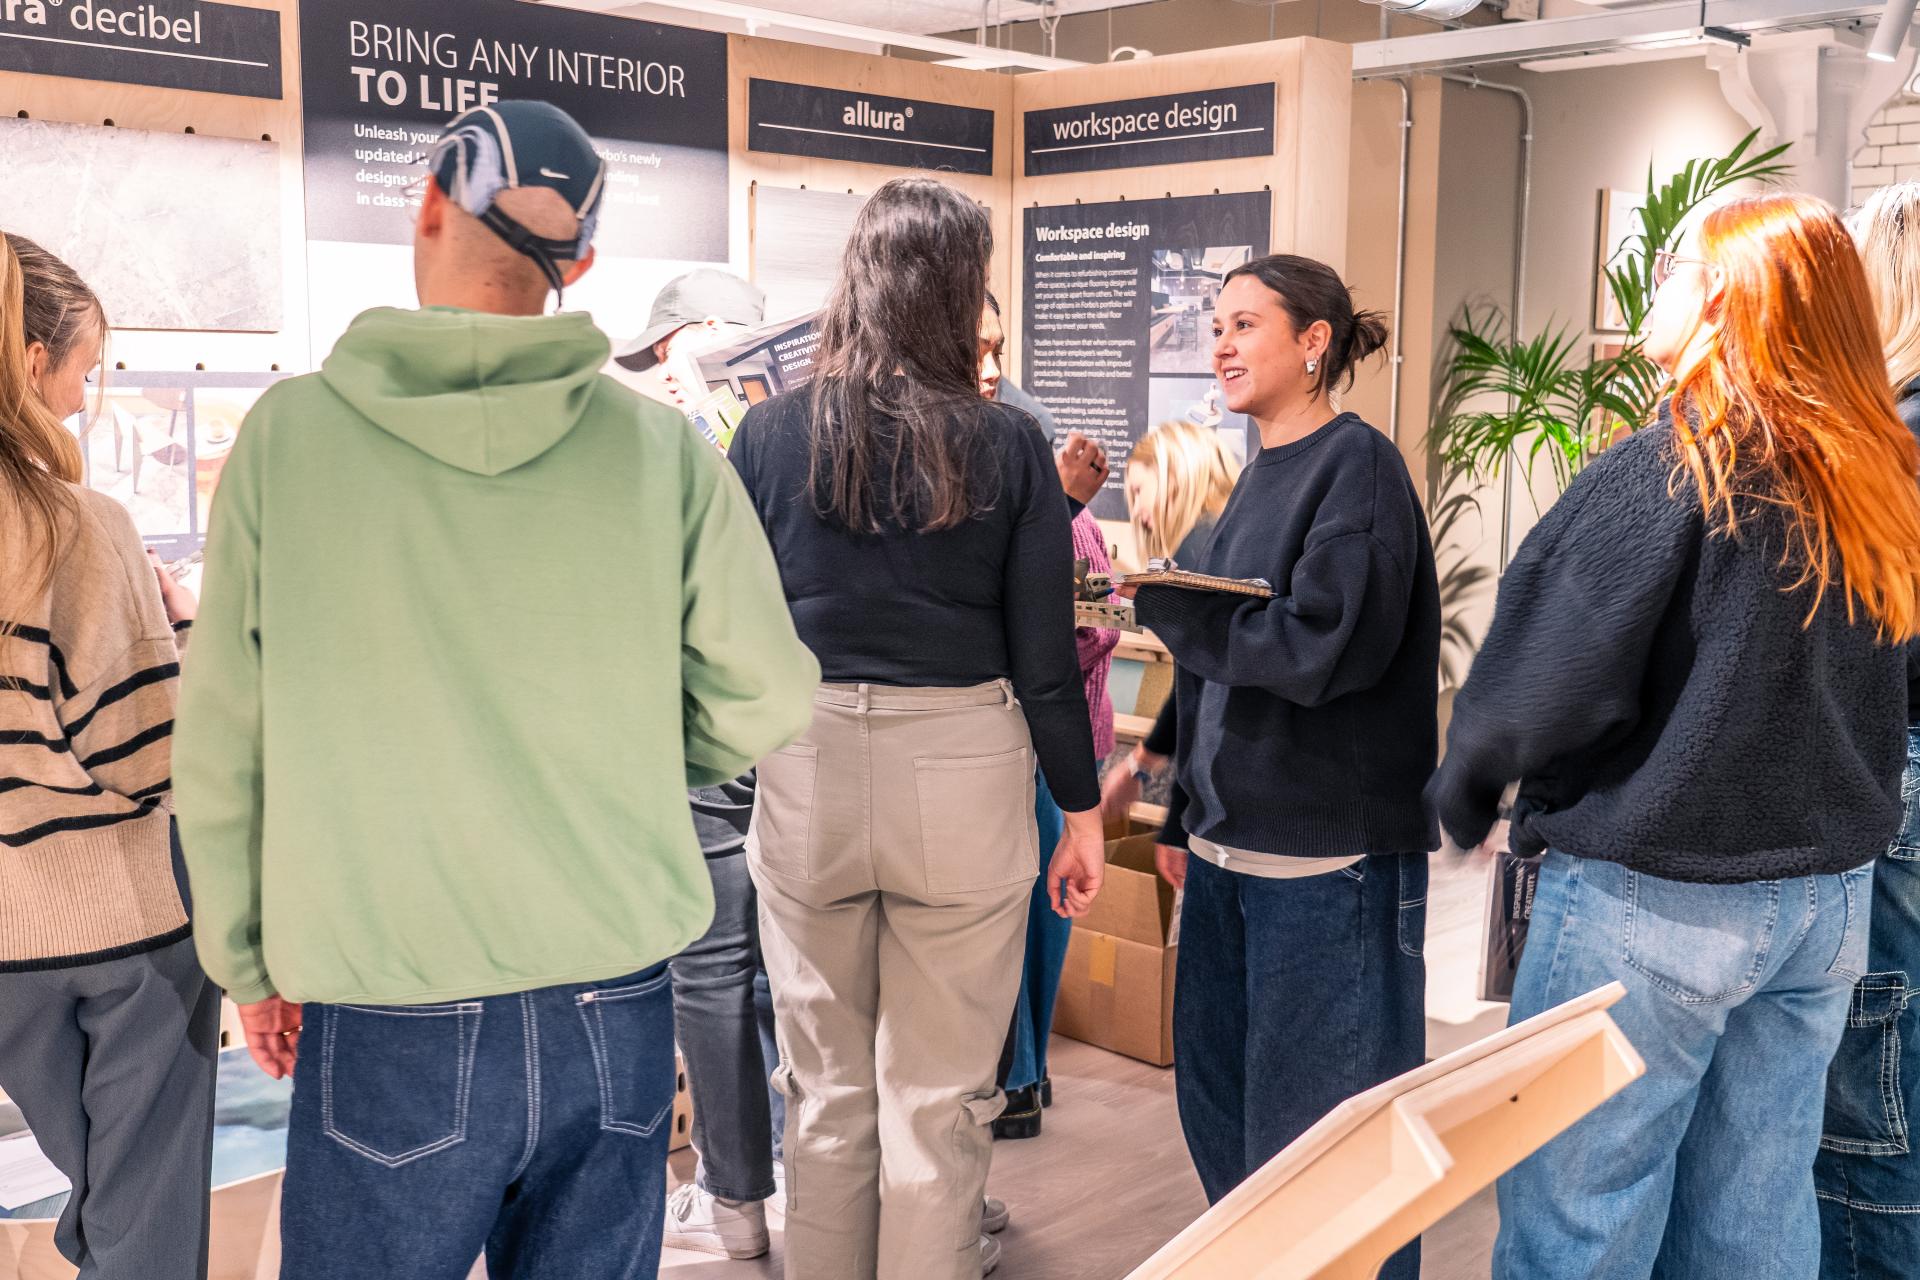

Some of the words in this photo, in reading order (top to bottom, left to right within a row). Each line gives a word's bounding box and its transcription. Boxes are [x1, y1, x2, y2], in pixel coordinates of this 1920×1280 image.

[70, 0, 200, 44] decibel
[350, 20, 458, 68] BRING
[469, 38, 538, 78] ANY
[549, 48, 685, 98] INTERIOR
[351, 66, 407, 106] TO
[842, 100, 914, 132] allura®
[1053, 112, 1160, 140] workspace
[1164, 100, 1237, 130] design
[354, 124, 408, 142] Unleash
[410, 132, 440, 146] your
[630, 153, 661, 168] newly
[355, 148, 412, 164] updated
[356, 169, 408, 188] designs
[356, 192, 370, 205] in
[1036, 226, 1103, 243] Workspace
[1106, 221, 1150, 240] design
[1035, 252, 1078, 262] Comfortable
[1079, 251, 1092, 260] and
[1094, 250, 1126, 261] inspiring
[1089, 280, 1109, 289] flooring
[1110, 279, 1127, 288] design
[1110, 310, 1122, 319] floor
[782, 357, 814, 372] DESIGN.
[1112, 439, 1133, 450] flooring
